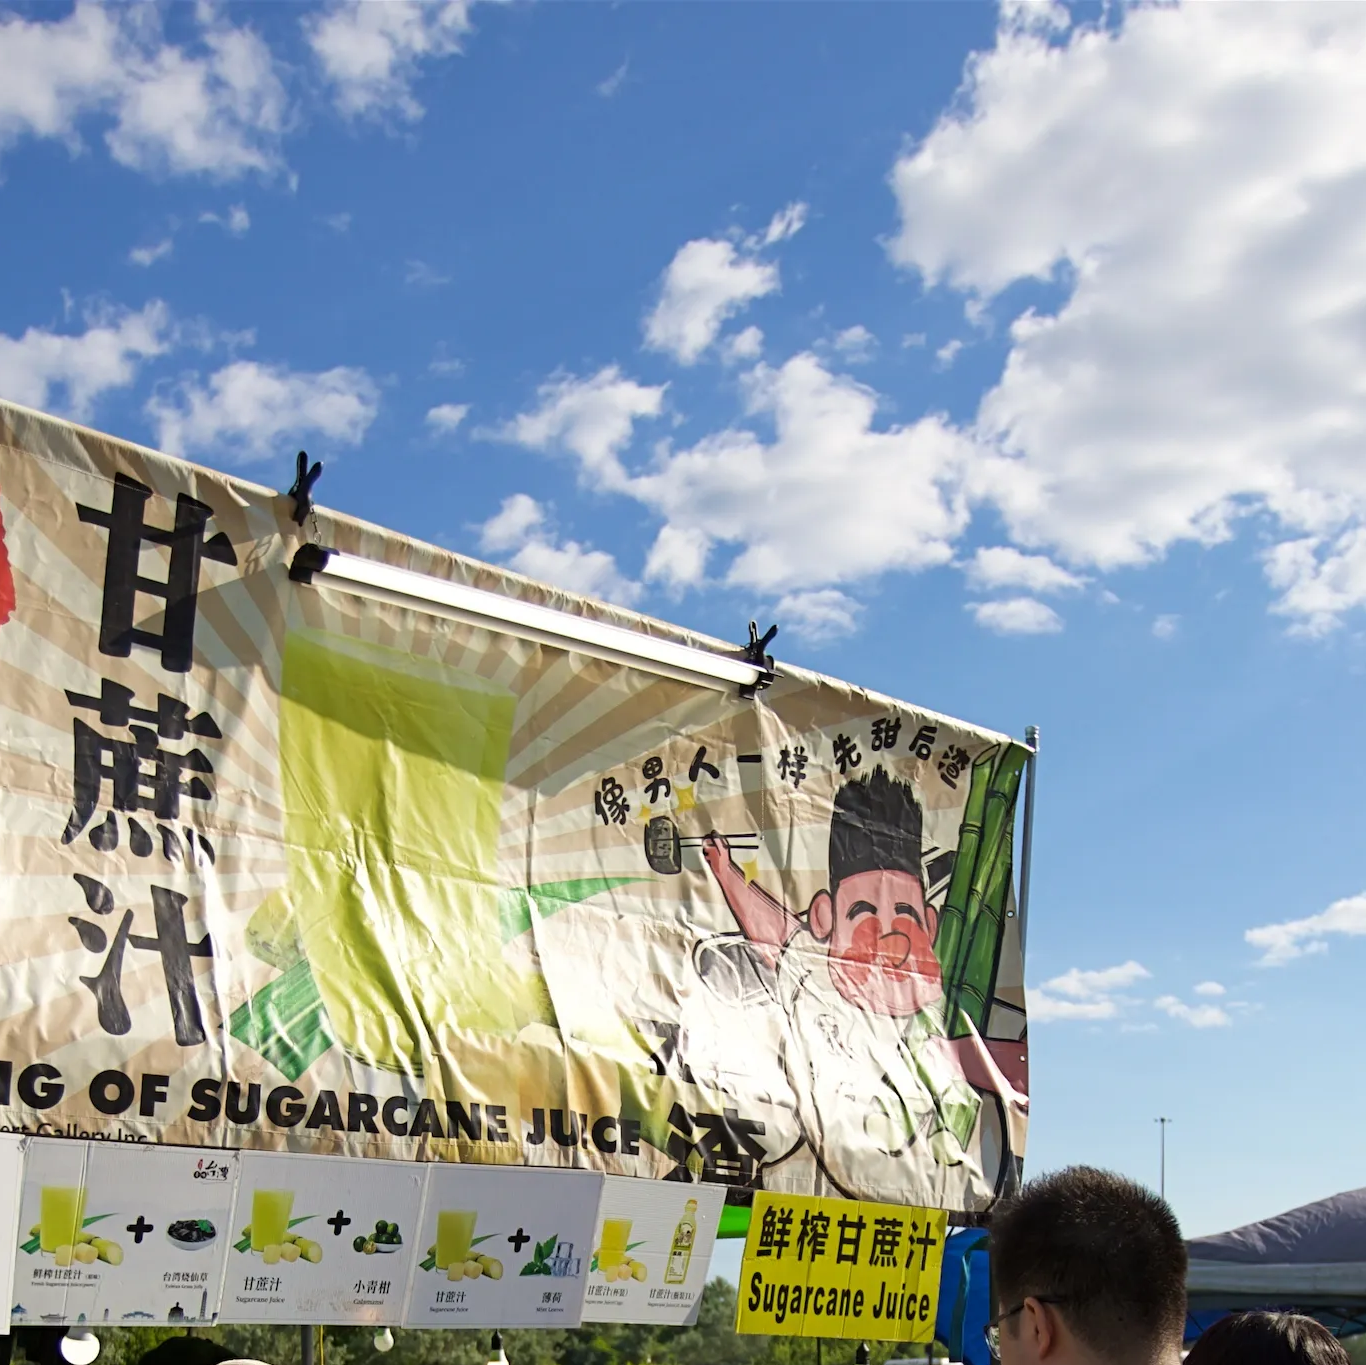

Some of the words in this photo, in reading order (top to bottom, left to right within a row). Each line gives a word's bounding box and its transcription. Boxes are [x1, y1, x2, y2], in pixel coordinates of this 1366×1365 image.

[61, 472, 237, 1046] 甘蔗汁
[595, 717, 971, 826] 像男人一样先甜后渣
[89, 1069, 170, 1117] OF
[191, 1078, 509, 1143] SUGARCANE
[527, 1107, 641, 1156] JUICE
[756, 1205, 937, 1272] 鲜榨甘蔗汁
[236, 1295, 268, 1304] Sugarcane
[269, 1296, 286, 1304] Juice
[243, 1276, 282, 1292] 甘蔗汁
[353, 1279, 392, 1294] 小青柑
[436, 1290, 467, 1303] 甘蔗汁
[748, 1271, 865, 1325] Sugarcane
[872, 1281, 931, 1323] Juice
